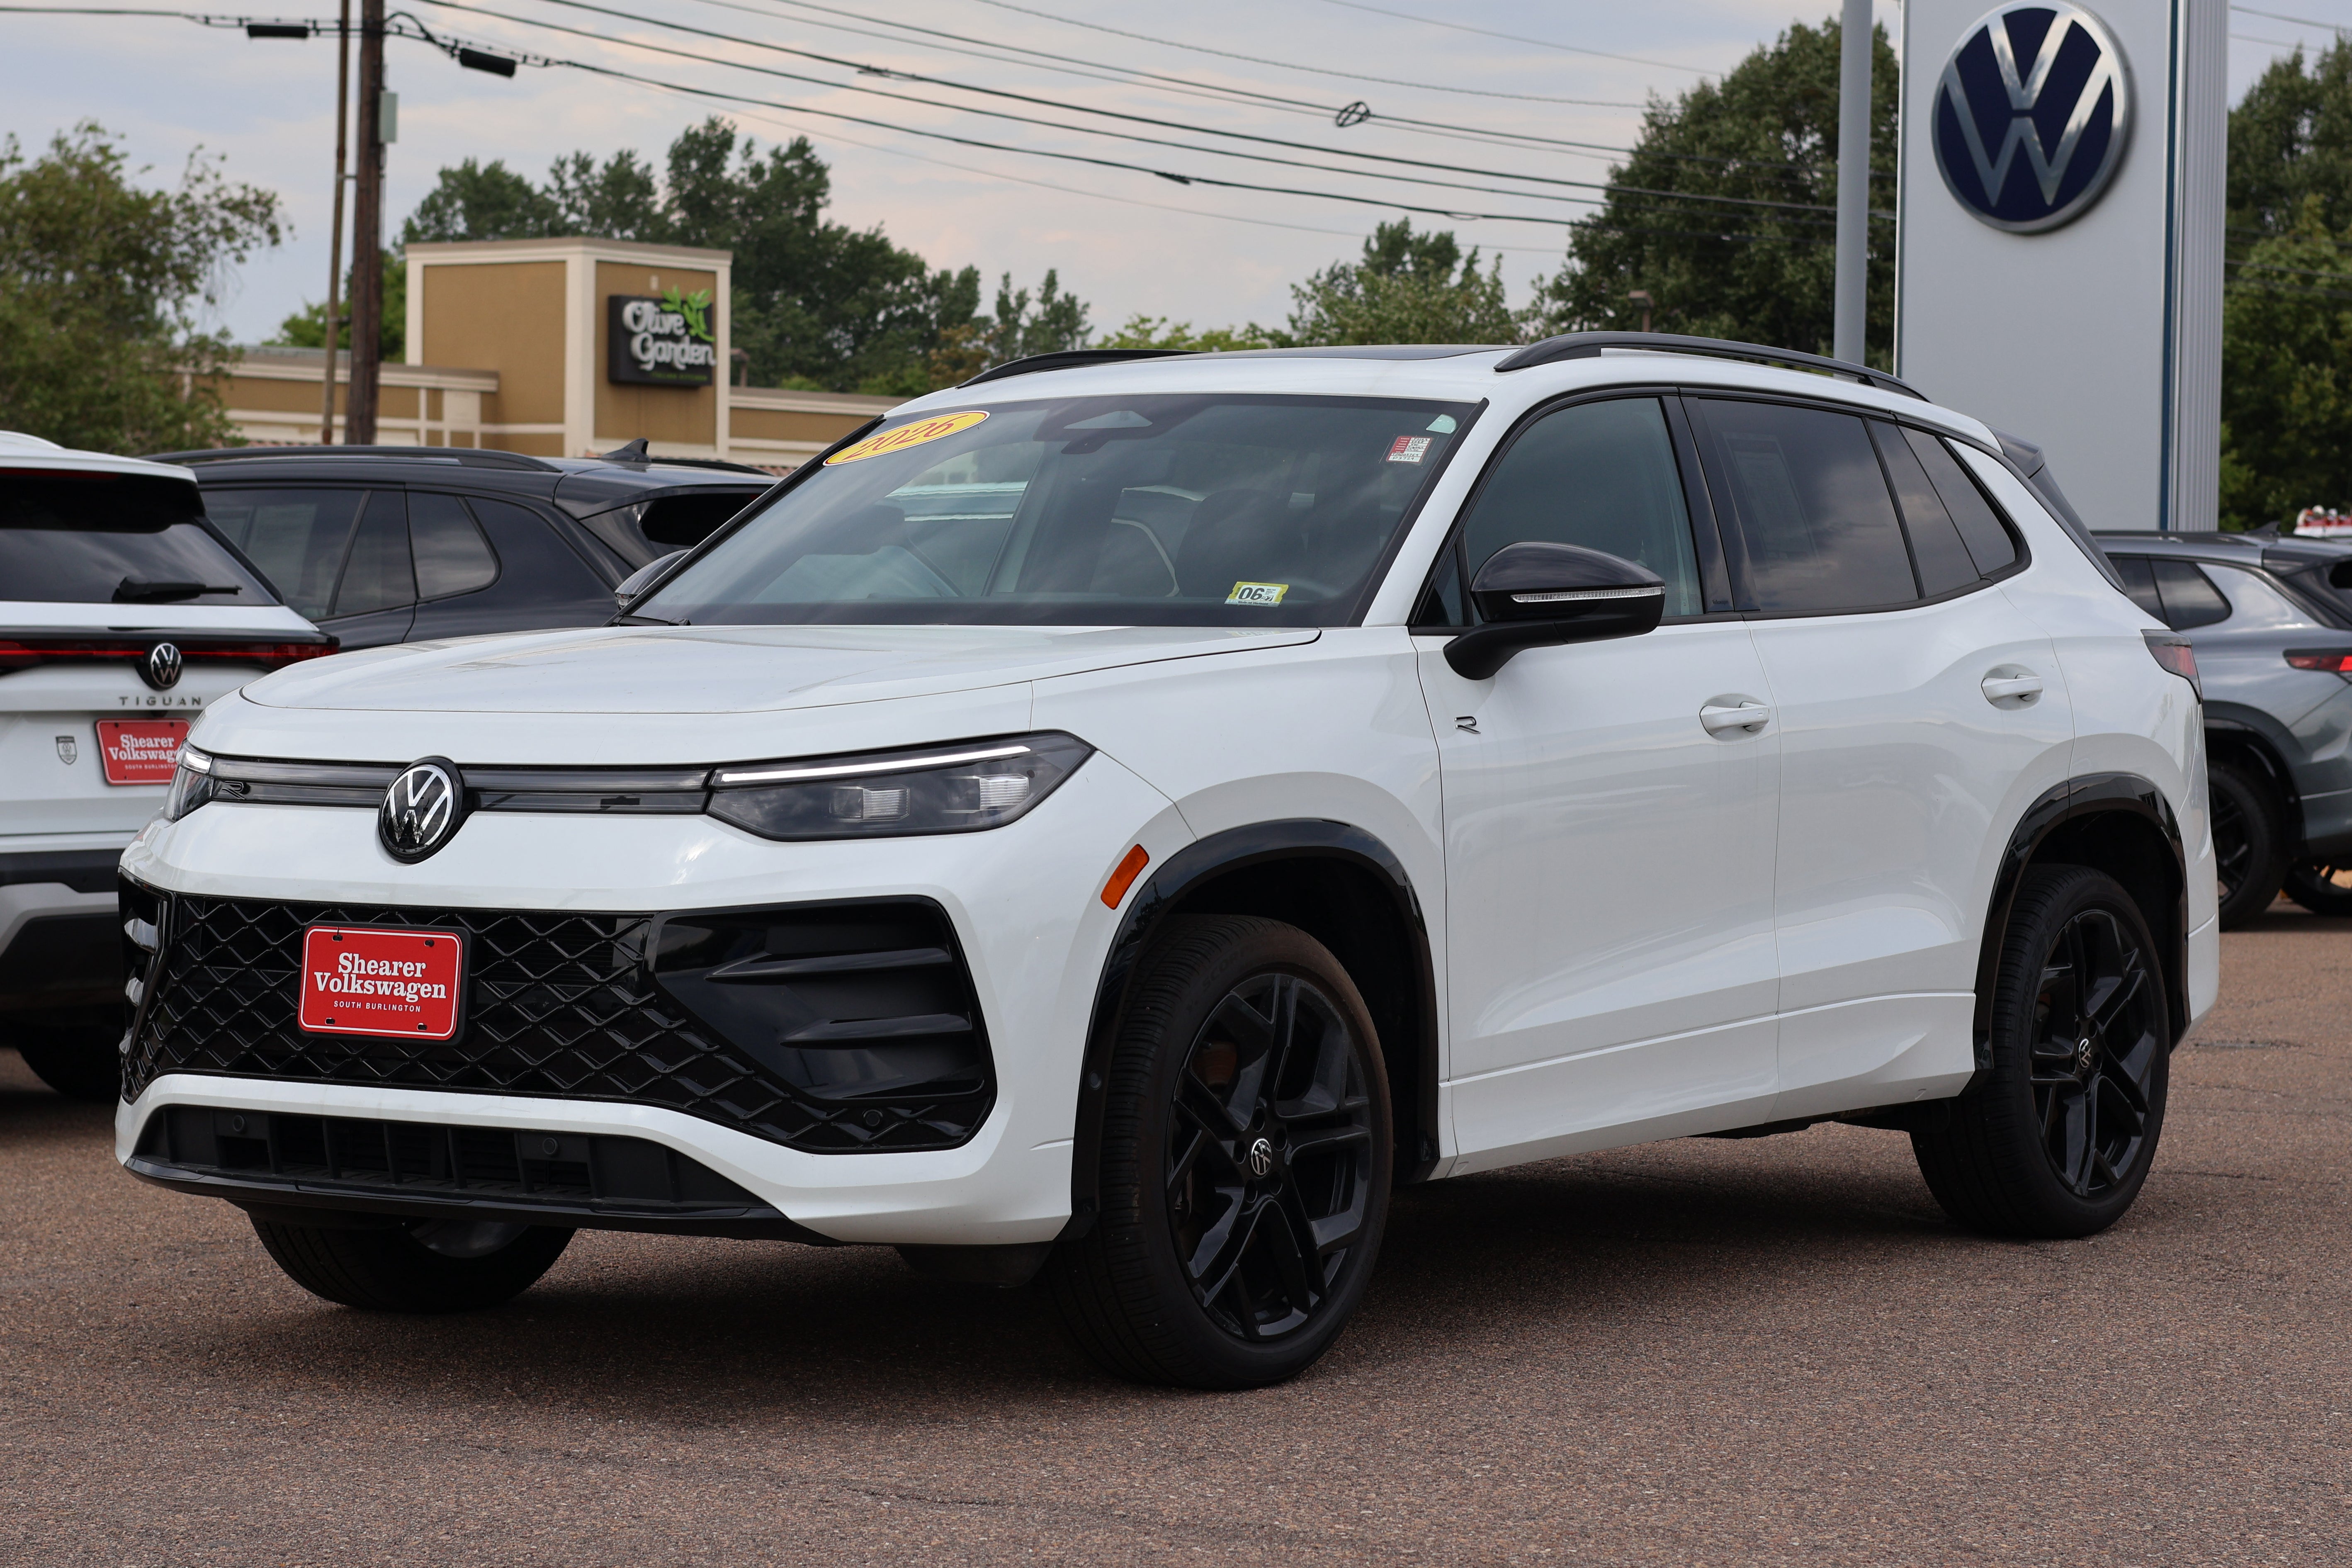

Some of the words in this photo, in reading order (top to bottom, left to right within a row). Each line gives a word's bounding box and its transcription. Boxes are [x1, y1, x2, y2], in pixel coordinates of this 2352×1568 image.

[623, 301, 686, 335] Olive
[631, 332, 717, 371] Garden
[841, 415, 969, 461] 2026
[1238, 587, 1265, 600] 06
[119, 696, 201, 705] TIGUAN
[120, 734, 175, 748] Shearer
[108, 747, 177, 763] Volkswag
[338, 953, 426, 977] Shearer
[314, 972, 446, 1002] Volkswagen
[366, 1002, 420, 1012] BURLINGTON
